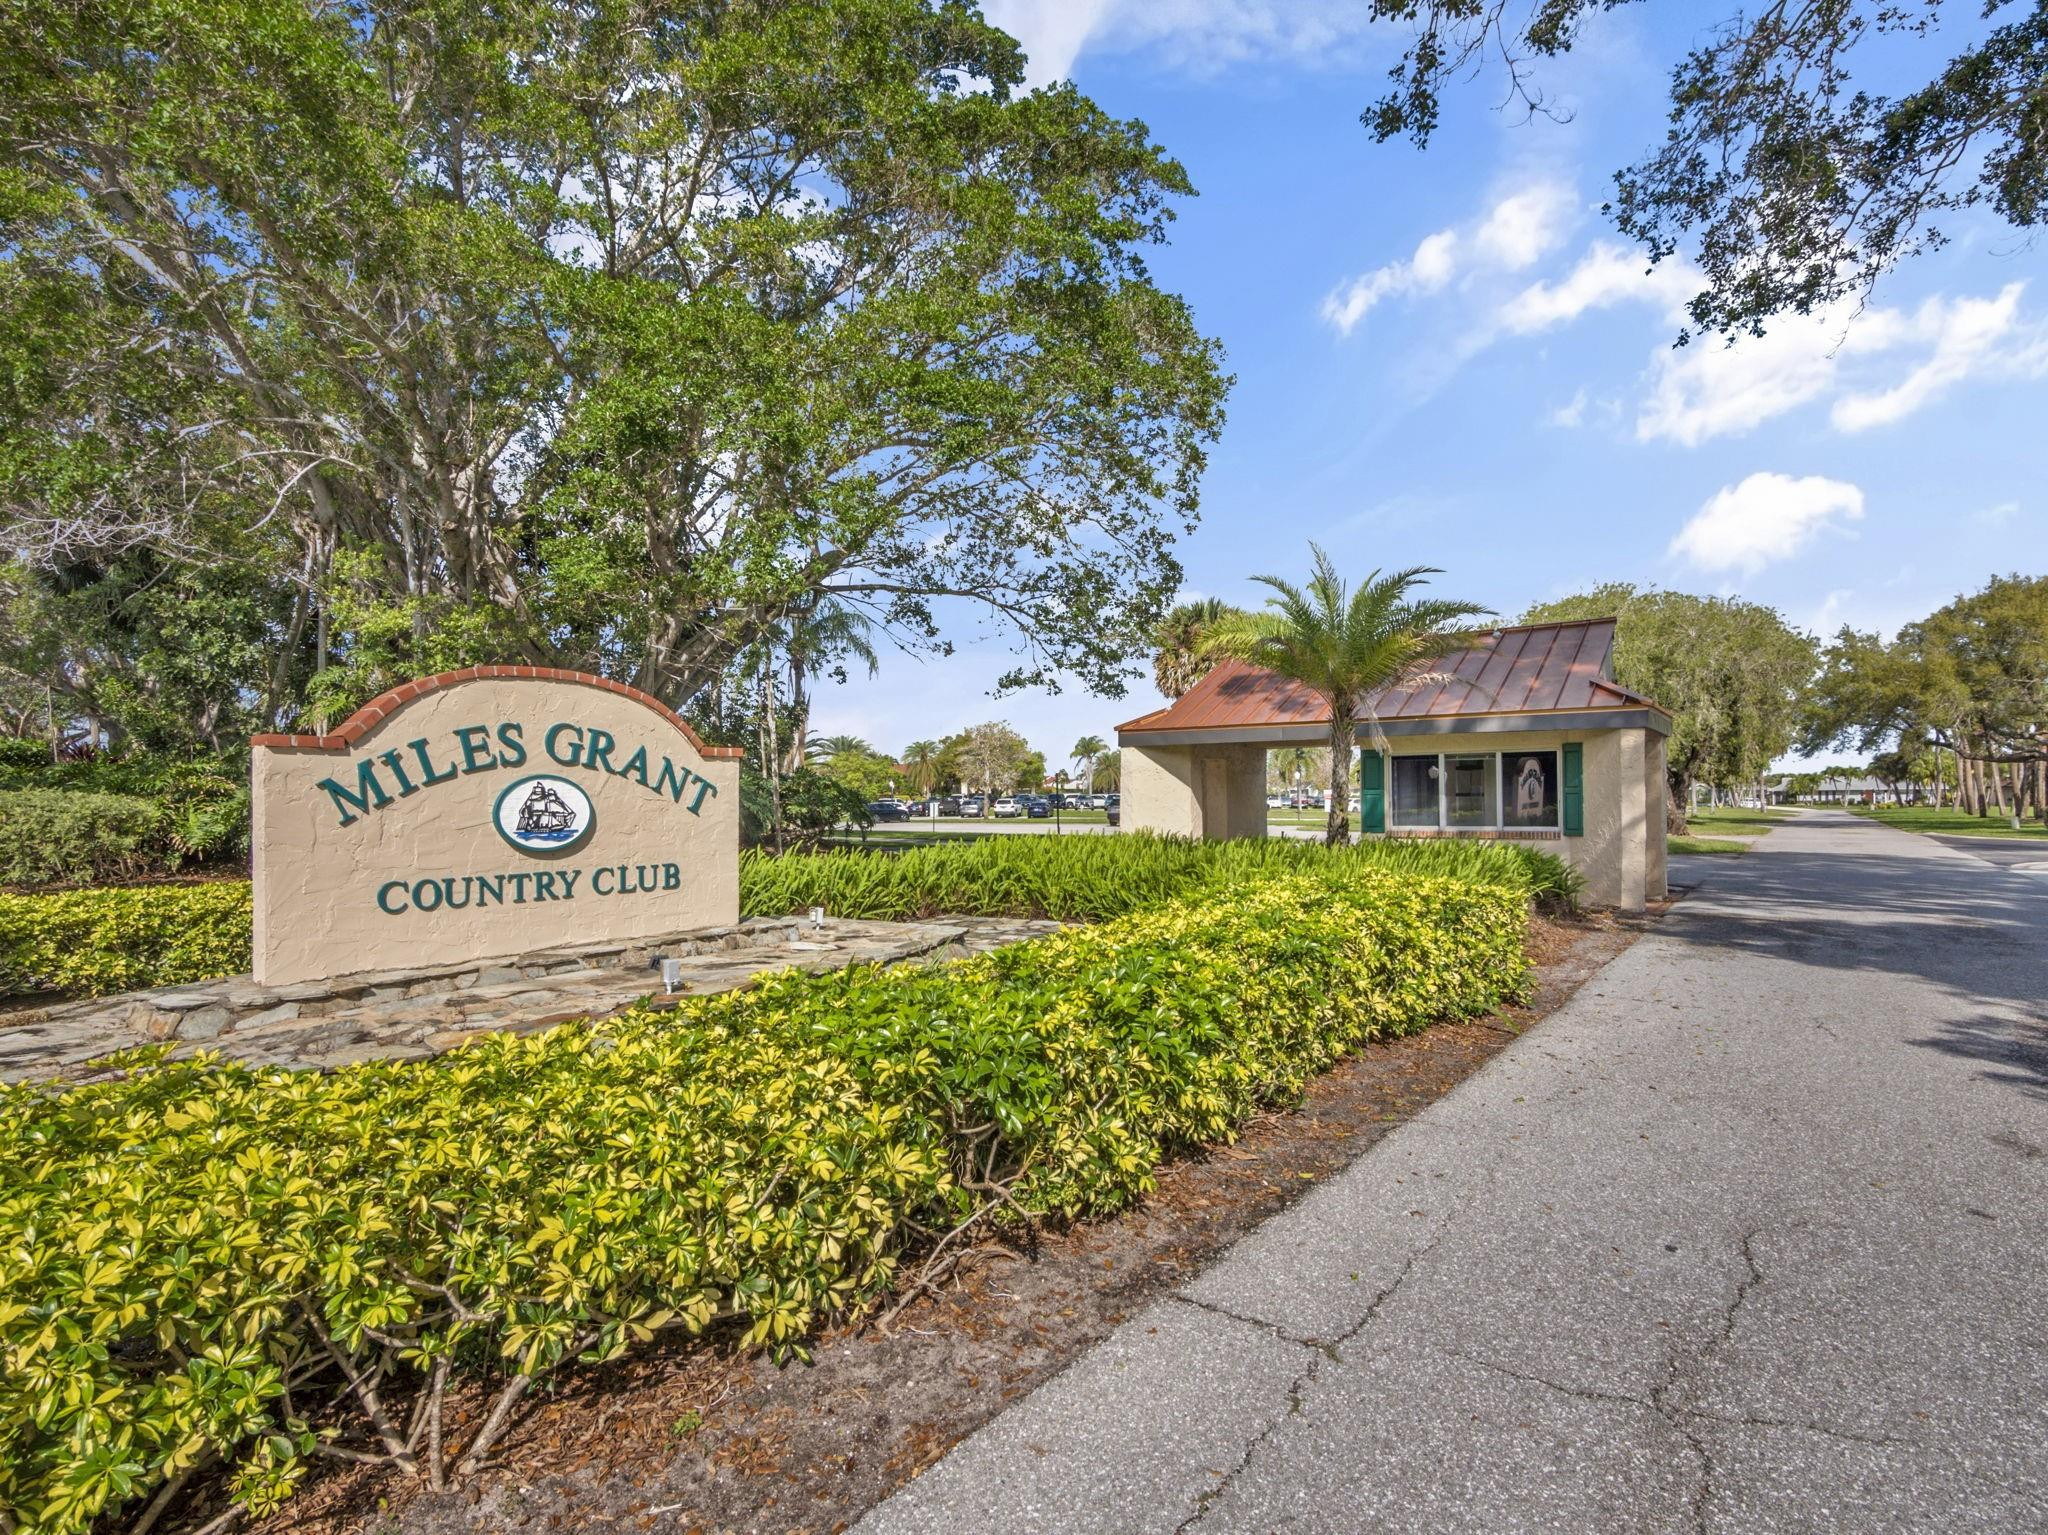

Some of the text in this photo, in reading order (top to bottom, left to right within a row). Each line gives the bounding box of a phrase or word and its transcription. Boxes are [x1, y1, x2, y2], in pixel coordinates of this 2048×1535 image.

[317, 722, 718, 826] MILES GRANT
[377, 863, 681, 914] COUNTRY CLUB
